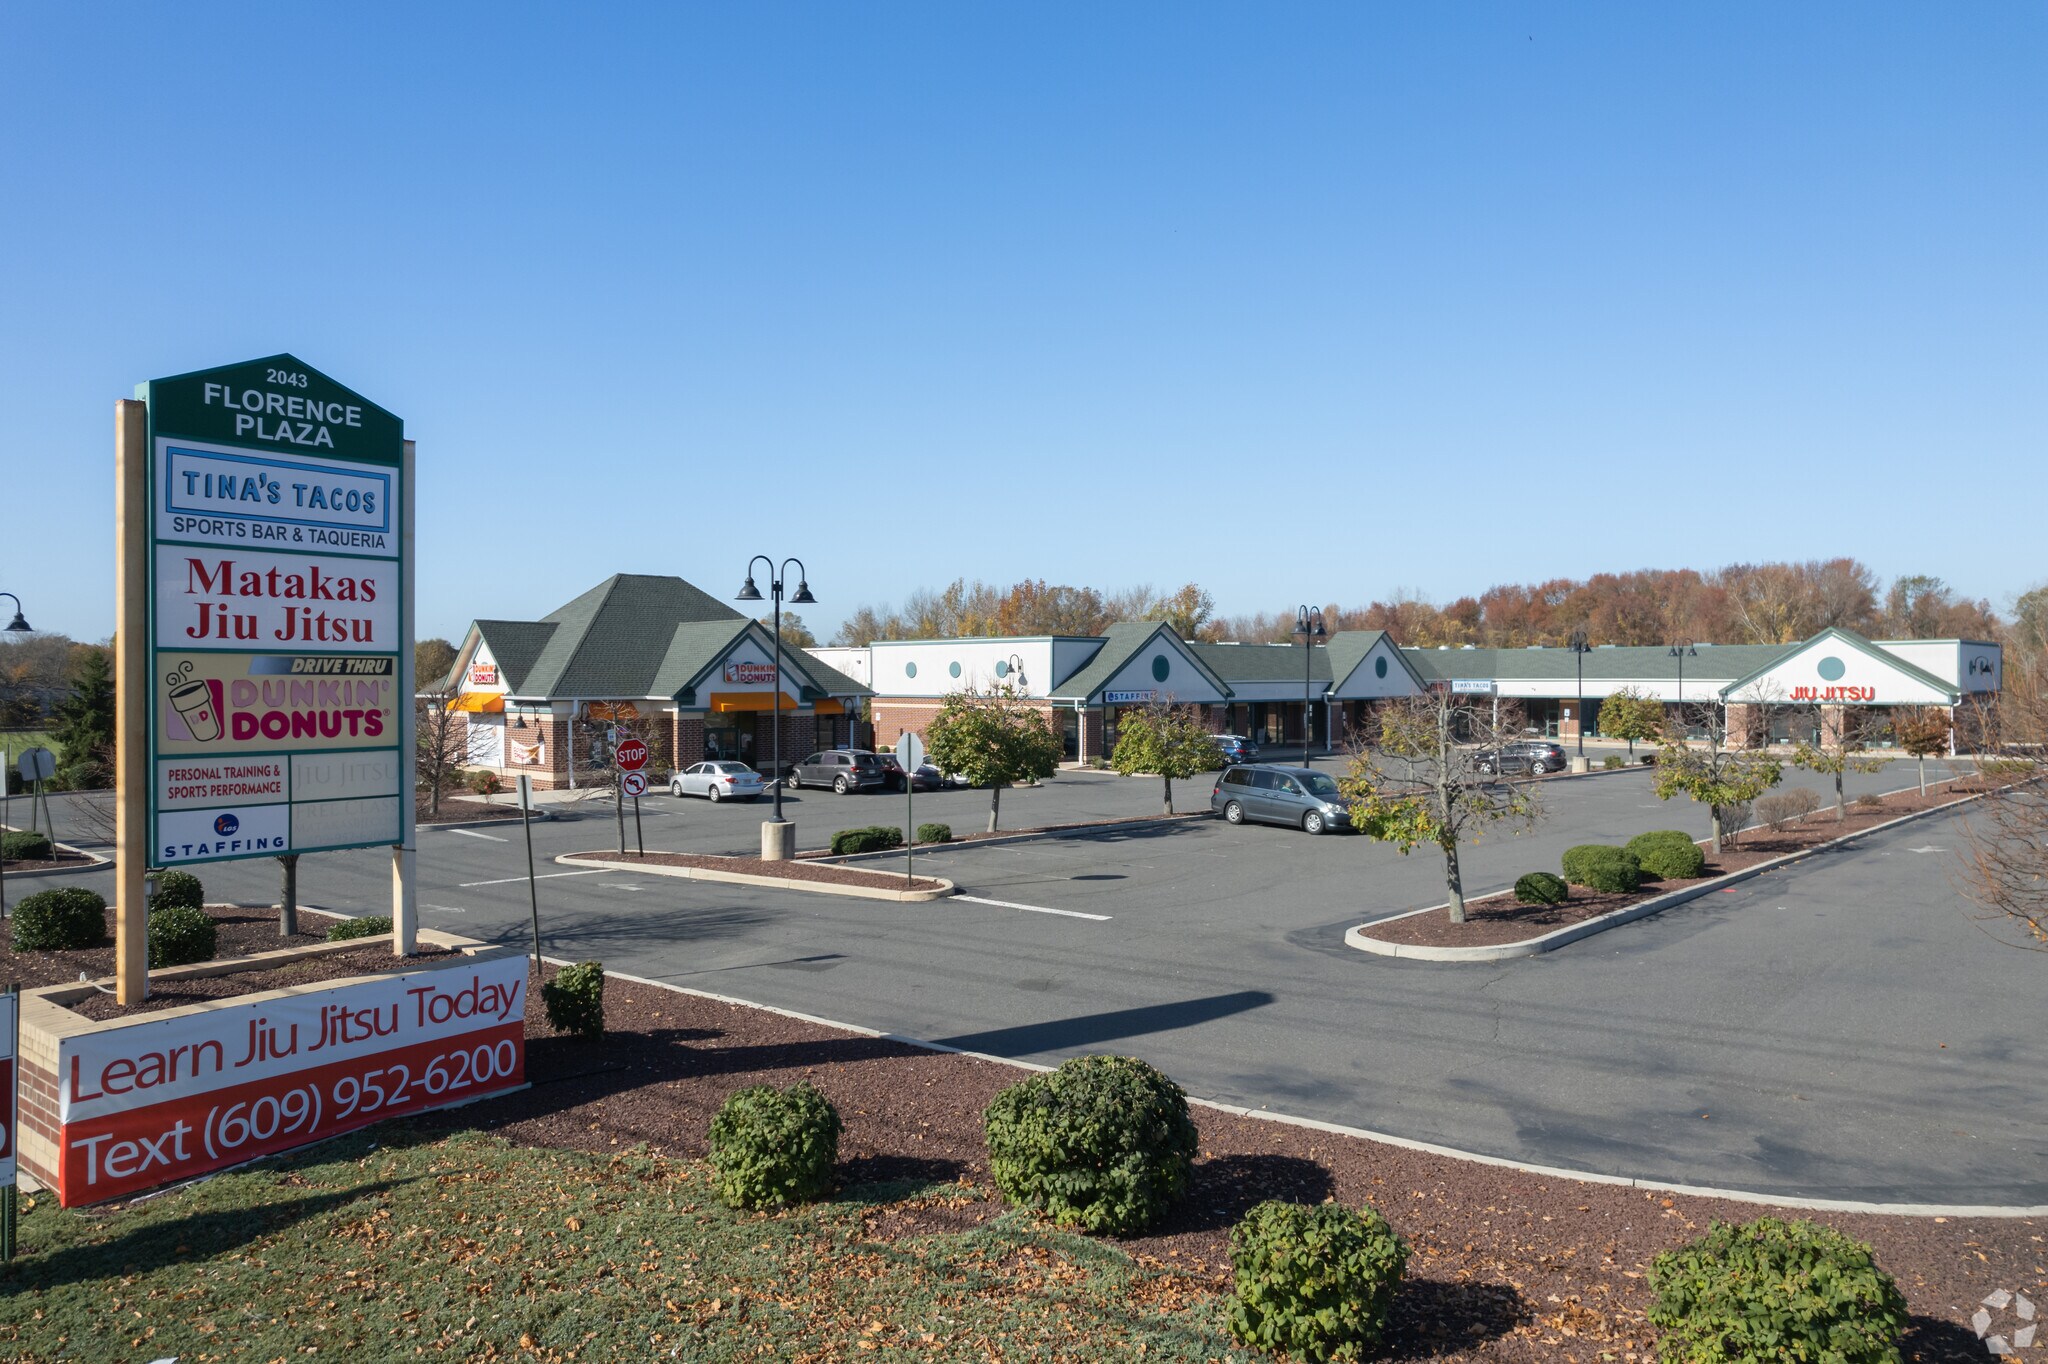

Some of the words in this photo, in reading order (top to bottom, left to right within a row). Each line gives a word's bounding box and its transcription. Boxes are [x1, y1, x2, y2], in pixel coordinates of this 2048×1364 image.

[266, 368, 308, 388] 2043
[204, 382, 362, 427] FLORENCE
[235, 413, 335, 449] PLAZA
[182, 470, 282, 505] TINA'S
[292, 483, 376, 514] TACOS
[172, 516, 247, 538] SPORTS
[252, 523, 288, 541] BAR
[292, 527, 304, 543] &
[308, 528, 386, 549] TAQUERIA
[183, 557, 377, 603] Matakas
[186, 602, 260, 640] Jiu
[274, 606, 374, 643] Jitsu
[291, 658, 345, 673] DRIVE
[345, 658, 388, 674] THRU
[740, 674, 775, 682] DONUTS
[230, 679, 390, 708] DUNKIN'
[1789, 686, 1817, 701] JIU
[1820, 686, 1875, 701] JITSU
[619, 748, 646, 763] STOP
[168, 766, 221, 782] PERSONAL
[223, 765, 271, 779] TRAINING
[273, 764, 281, 777] &
[168, 785, 208, 799] SPORTS
[210, 781, 281, 797] PERFORMANCE
[164, 836, 285, 858] STAFFING
[71, 1039, 224, 1104] Learn
[234, 1017, 298, 1069] Jiu
[308, 1001, 399, 1052] Jitsu
[406, 976, 521, 1027] Today
[71, 1118, 191, 1185] Text
[203, 1082, 322, 1159] (609)
[332, 1039, 517, 1117] 952-6200
